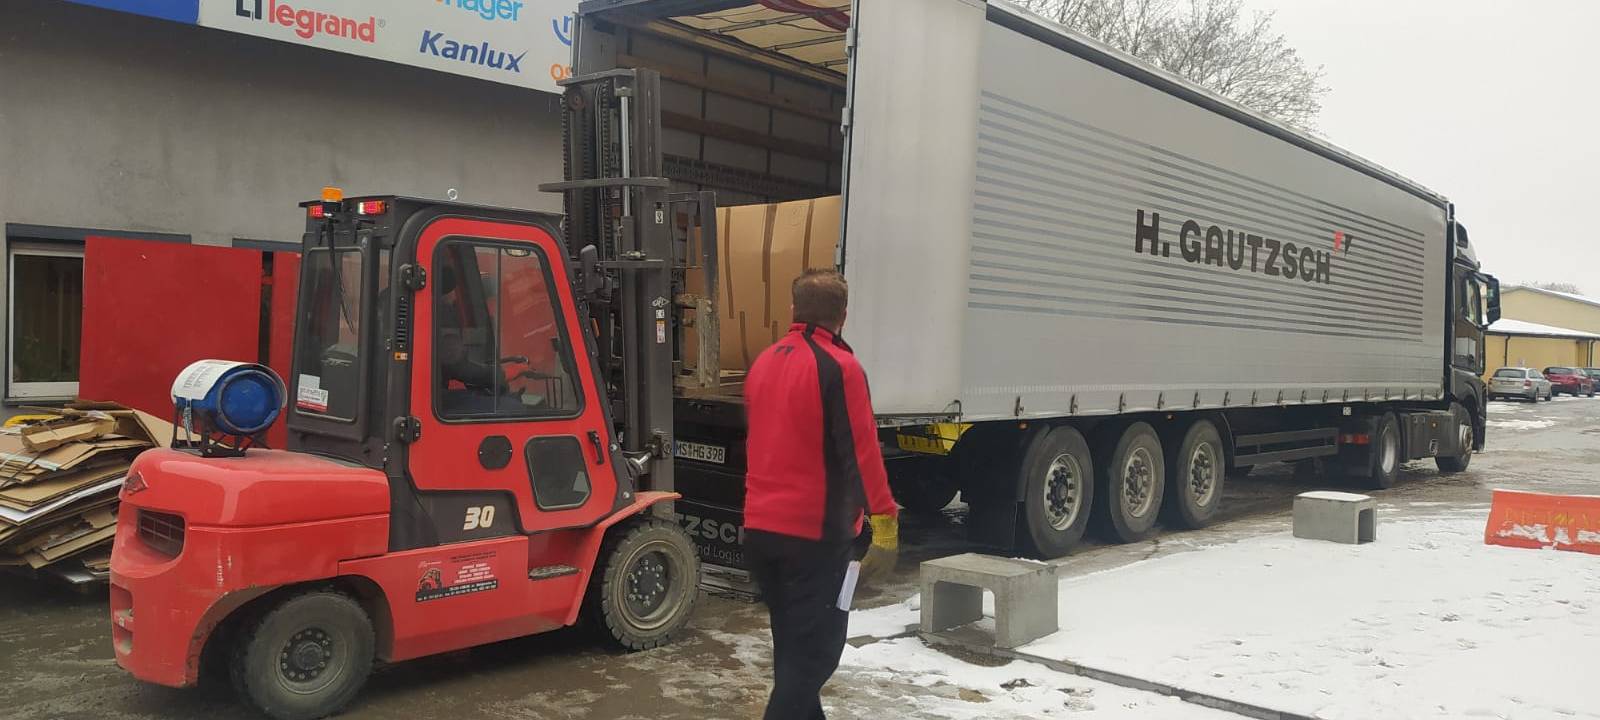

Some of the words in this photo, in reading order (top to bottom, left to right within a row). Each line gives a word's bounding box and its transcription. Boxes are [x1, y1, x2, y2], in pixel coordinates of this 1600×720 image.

[268, 0, 375, 42] legrand
[446, 0, 523, 21] ager
[419, 30, 528, 72] Kanlux
[1135, 209, 1170, 257] H.
[1179, 219, 1331, 284] GAUTZSCH
[706, 447, 724, 462] 398
[463, 506, 495, 530] 30
